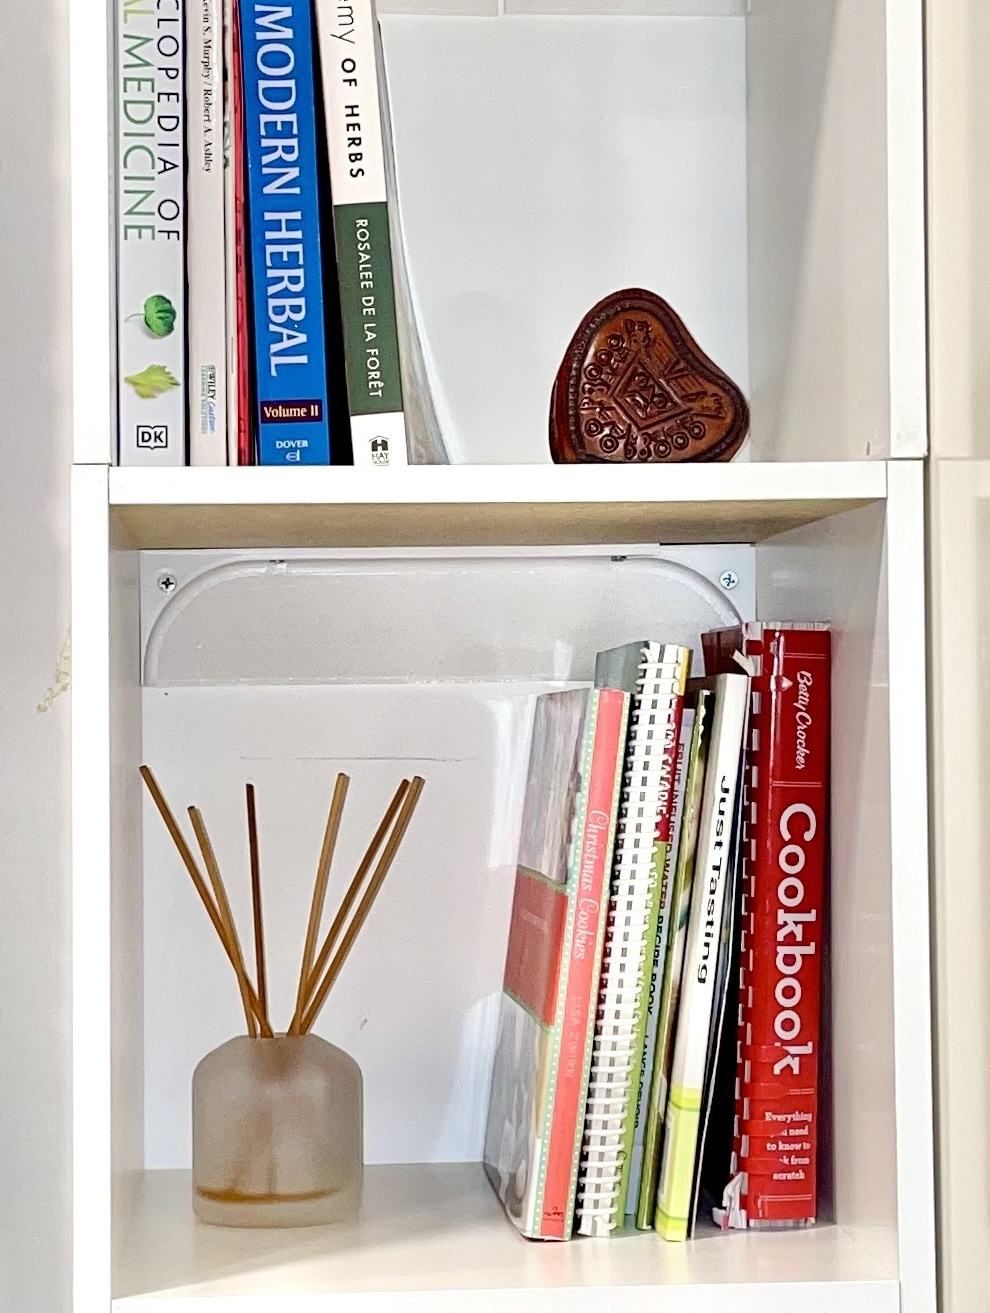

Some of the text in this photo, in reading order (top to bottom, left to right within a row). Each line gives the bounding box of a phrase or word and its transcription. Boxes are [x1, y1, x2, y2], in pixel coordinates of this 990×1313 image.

[200, 38, 212, 80] Murphy
[340, 58, 358, 88] OF
[202, 88, 212, 123] Robert
[254, 3, 301, 195] MODERN
[122, 34, 156, 241] MEDICINE
[344, 104, 365, 178] HERBS
[202, 140, 214, 173] Ashley
[157, 199, 180, 241] OF
[263, 210, 308, 378] HERBAL
[354, 218, 384, 398] ROSALEE DE LA FORÊT
[208, 373, 216, 400] WILEY
[264, 404, 318, 419] Volume II
[140, 430, 165, 444] DK
[275, 440, 308, 450] DOVER
[793, 670, 813, 770] Betty Crocker
[572, 808, 609, 960] Christmas Cookies
[698, 775, 730, 984] Just Tasting
[772, 802, 816, 1076] Cookbook
[764, 1110, 812, 1124] Everything
[788, 1124, 809, 1136] need
[766, 1140, 811, 1151] to know to
[790, 1154, 810, 1165] from
[772, 1168, 806, 1181] scratch
